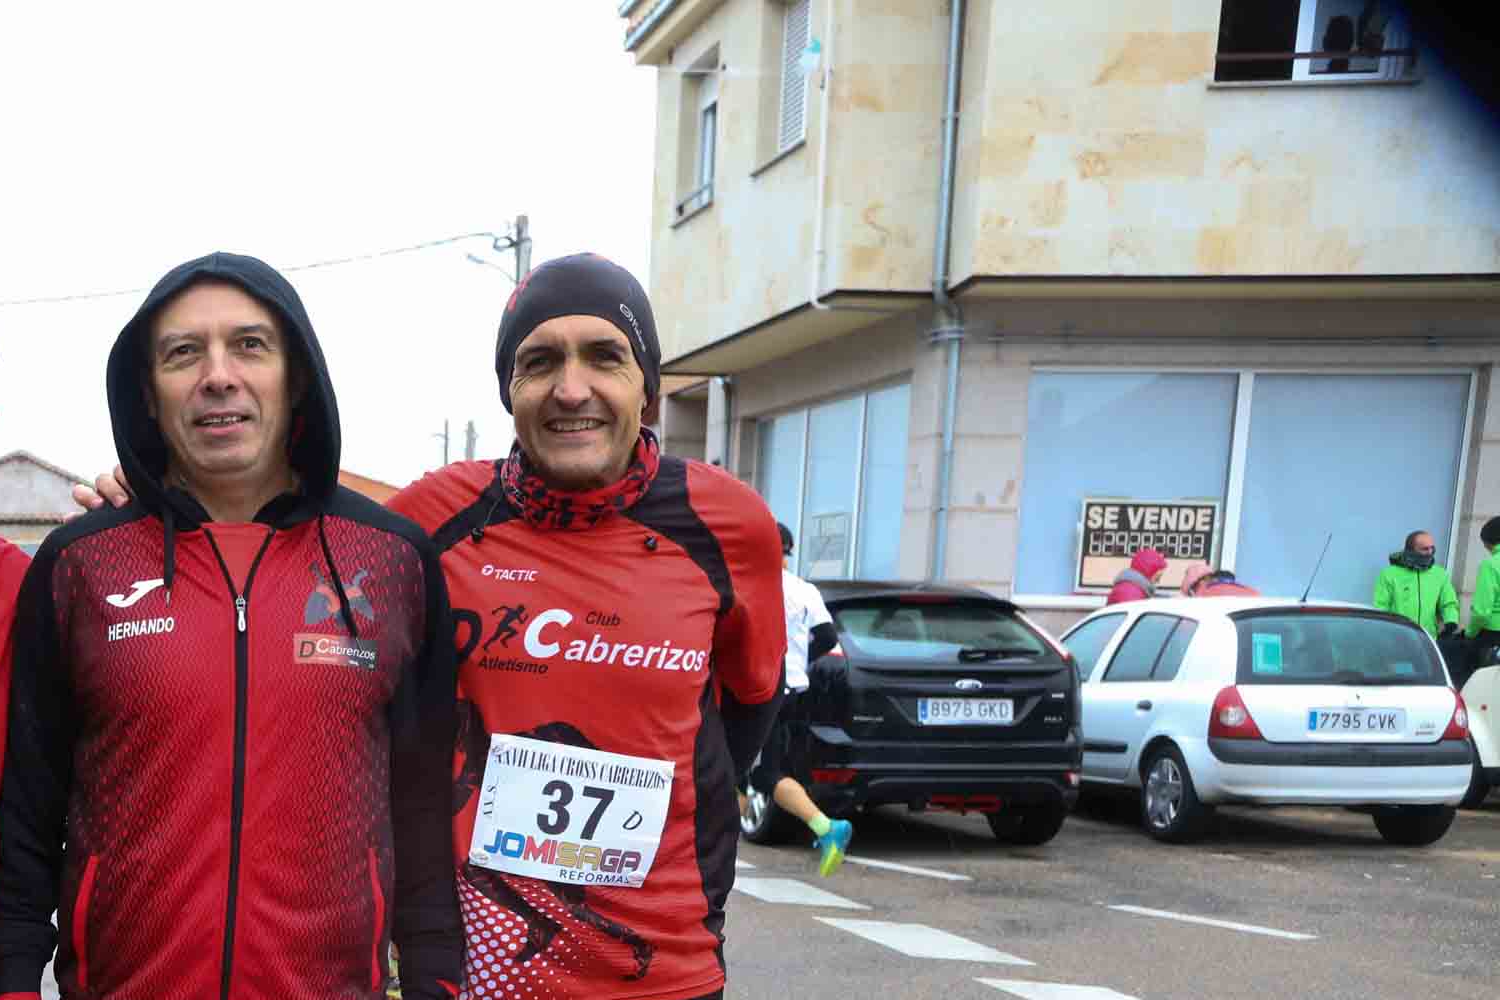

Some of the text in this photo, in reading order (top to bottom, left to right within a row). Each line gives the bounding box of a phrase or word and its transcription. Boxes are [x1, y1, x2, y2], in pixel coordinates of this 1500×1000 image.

[1087, 505, 1213, 532] SE VENDE
[494, 568, 539, 582] TACTIC
[108, 616, 175, 642] HERNANDO
[585, 611, 621, 627] Club
[524, 608, 706, 672] Cabrerizos
[478, 656, 549, 675] Atletismo
[1319, 713, 1397, 729] 7795 CVK
[530, 751, 556, 773] LIGA
[560, 756, 597, 780] CROSS
[600, 764, 665, 791] CABRERIZOS
[536, 779, 615, 841] 37
[622, 811, 643, 831] D
[484, 830, 642, 874] JOMISAGA
